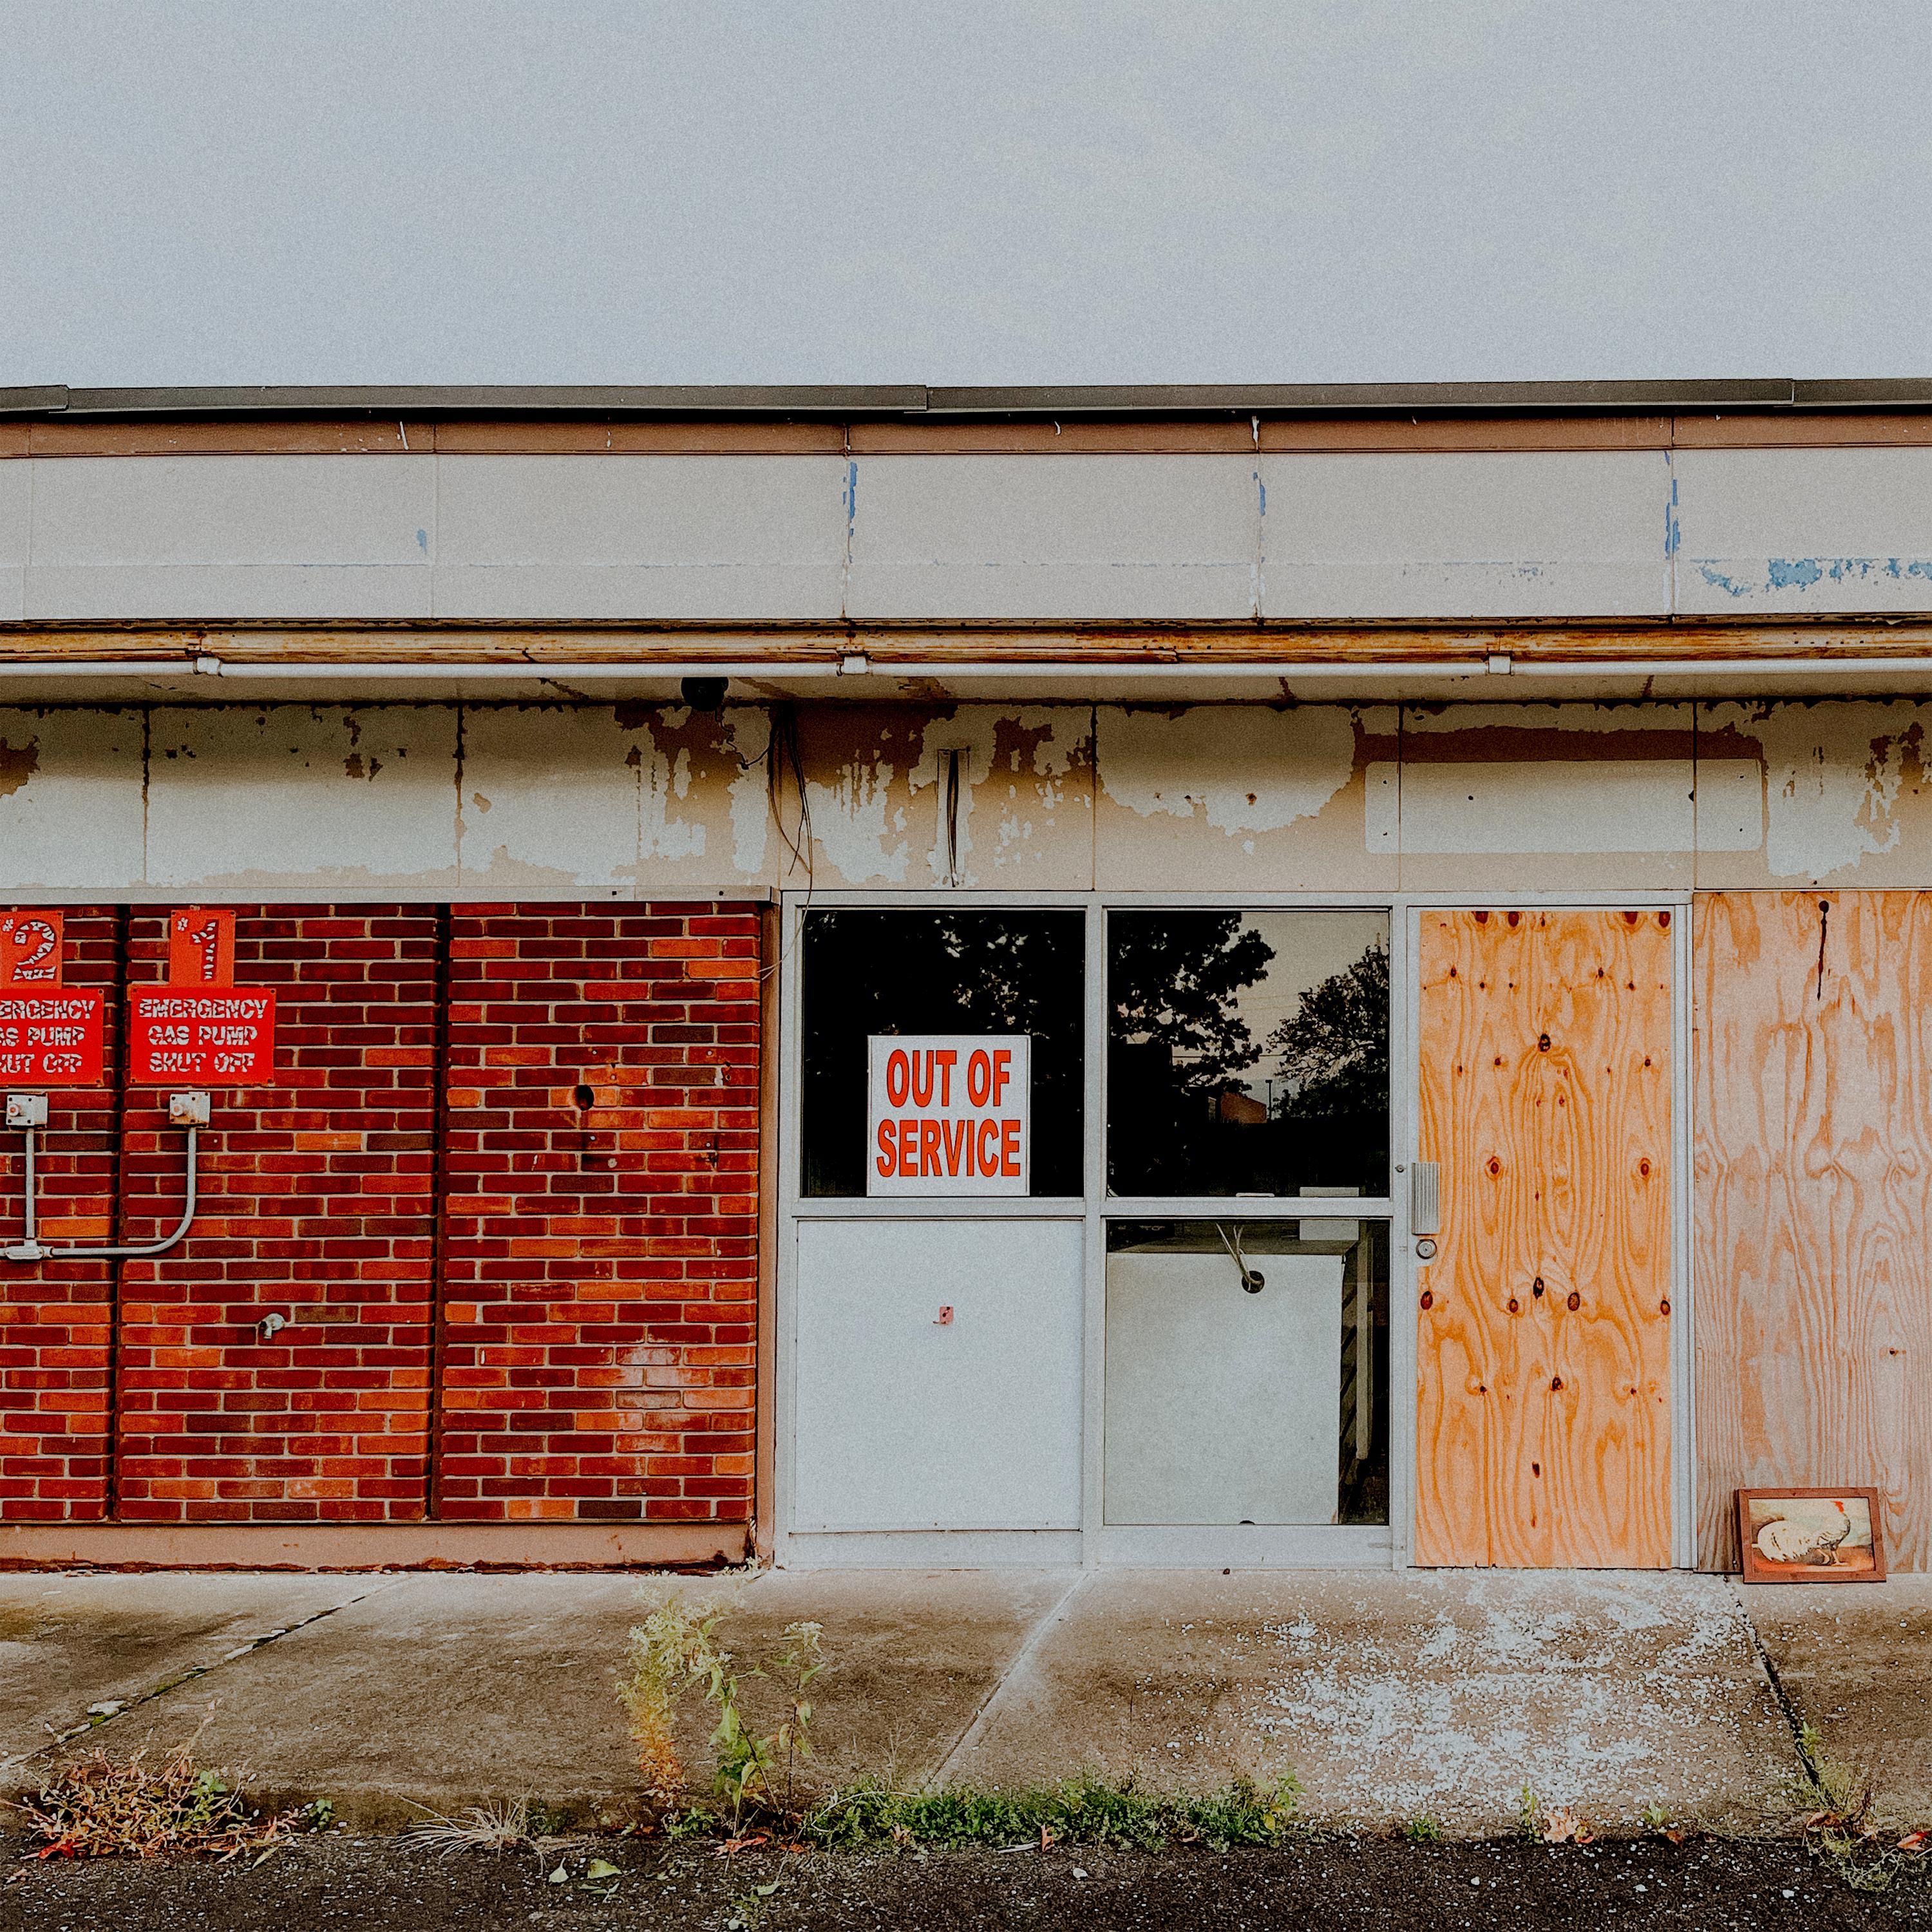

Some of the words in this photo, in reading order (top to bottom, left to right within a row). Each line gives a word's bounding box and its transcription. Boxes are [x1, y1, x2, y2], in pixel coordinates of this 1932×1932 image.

[139, 999, 268, 1019] EMERGENCY
[27, 1027, 85, 1046] PUMP
[148, 1025, 189, 1045] GAS
[198, 1025, 257, 1045] PUMP
[43, 1053, 83, 1074] OFF
[149, 1052, 206, 1072] SHUT
[214, 1052, 255, 1072] OFF
[887, 1049, 957, 1107] OUT
[967, 1049, 1011, 1107] OF
[876, 1119, 1021, 1177] SERVICE
